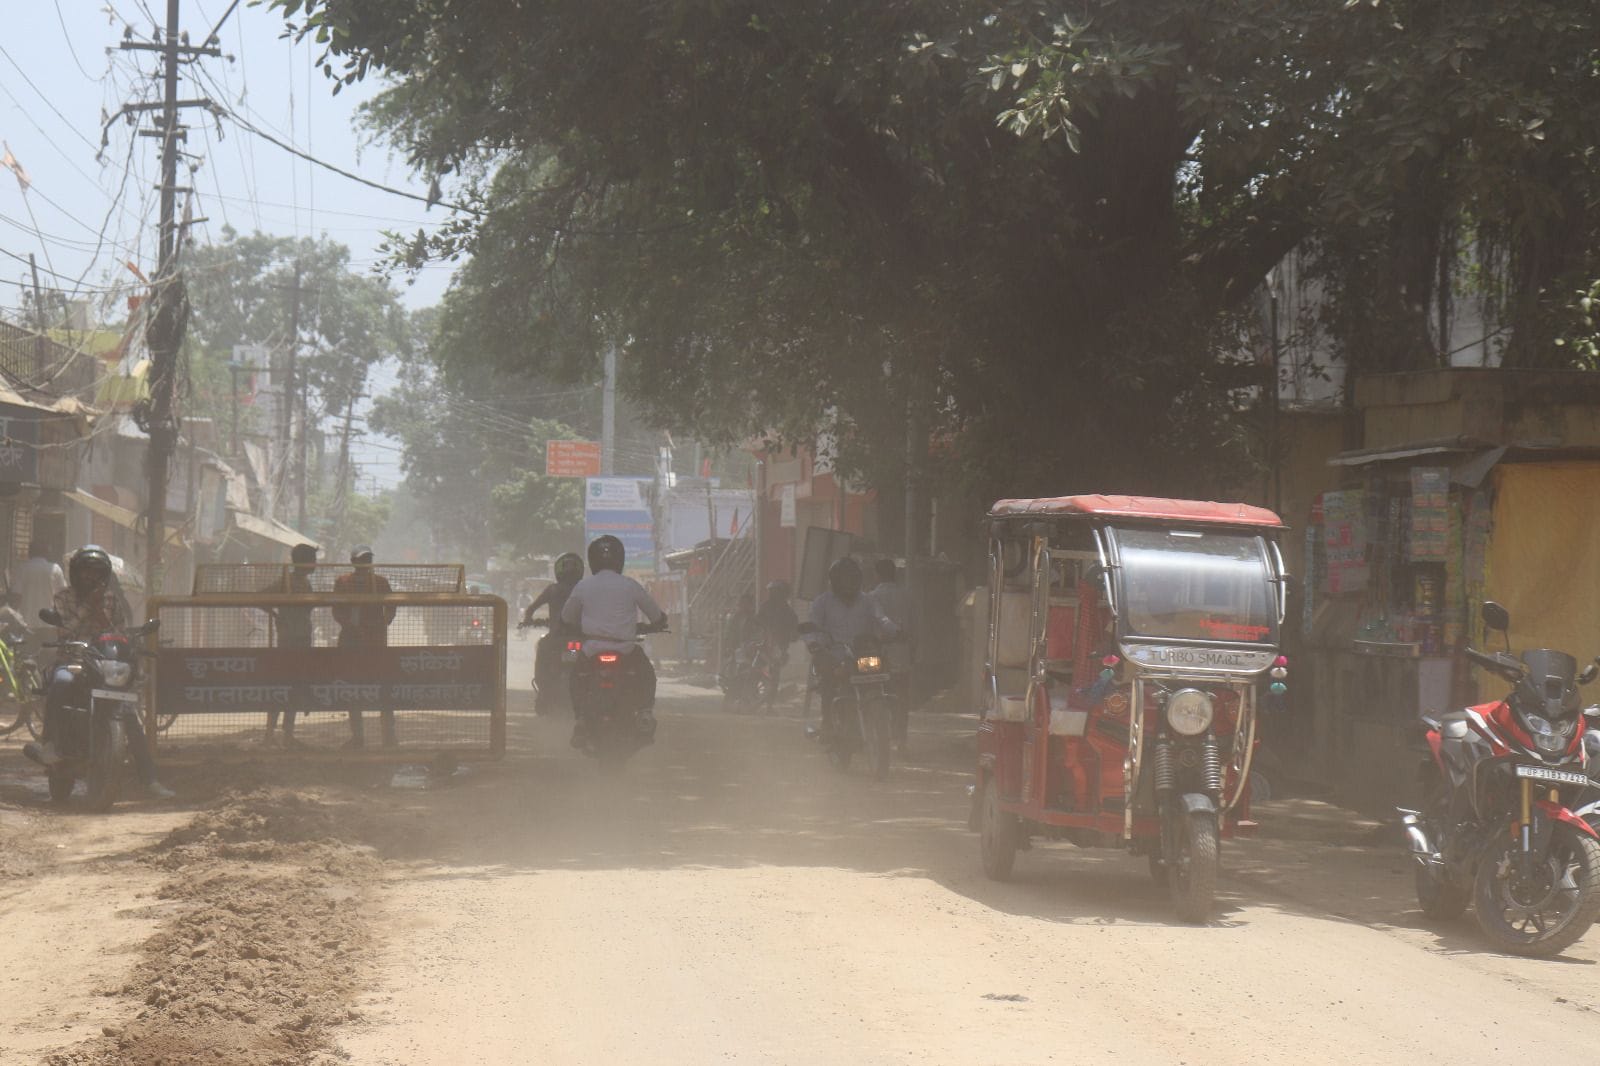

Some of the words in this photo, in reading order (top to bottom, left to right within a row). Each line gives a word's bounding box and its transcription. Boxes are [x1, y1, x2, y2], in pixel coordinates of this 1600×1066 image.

[1150, 649, 1194, 663] TURBO
[1198, 651, 1241, 666] SMART
[184, 685, 292, 705] यातायात
[311, 679, 382, 706] पुलिस
